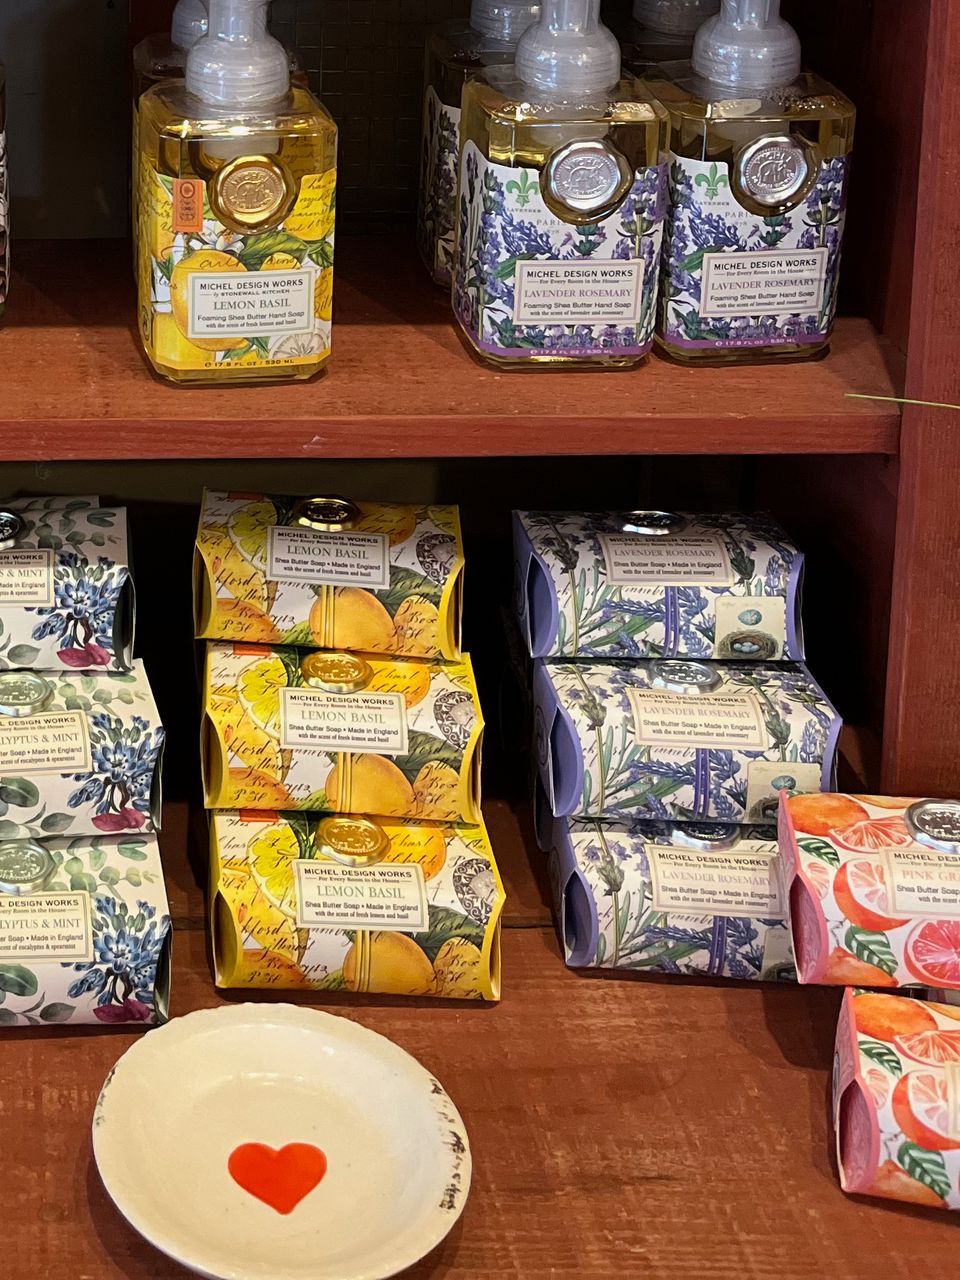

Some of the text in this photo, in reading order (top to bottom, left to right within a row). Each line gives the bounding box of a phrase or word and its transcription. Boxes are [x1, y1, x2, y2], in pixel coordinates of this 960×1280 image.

[237, 281, 269, 289] DESIGN
[272, 279, 303, 287] WORKS
[711, 278, 814, 290] LAVENDER ROSEMARY
[524, 289, 632, 298] LAVENDER ROSEMARY
[214, 299, 291, 310] LEMON BASIL
[288, 545, 369, 559] LEMON BASIL
[643, 707, 751, 719] LAVENDER ROSEMARY
[902, 870, 934, 880] PINK
[317, 886, 405, 899] LEMON BASIL
[42, 920, 50, 928] &
[53, 919, 80, 928] MINT
[58, 934, 83, 942] England
